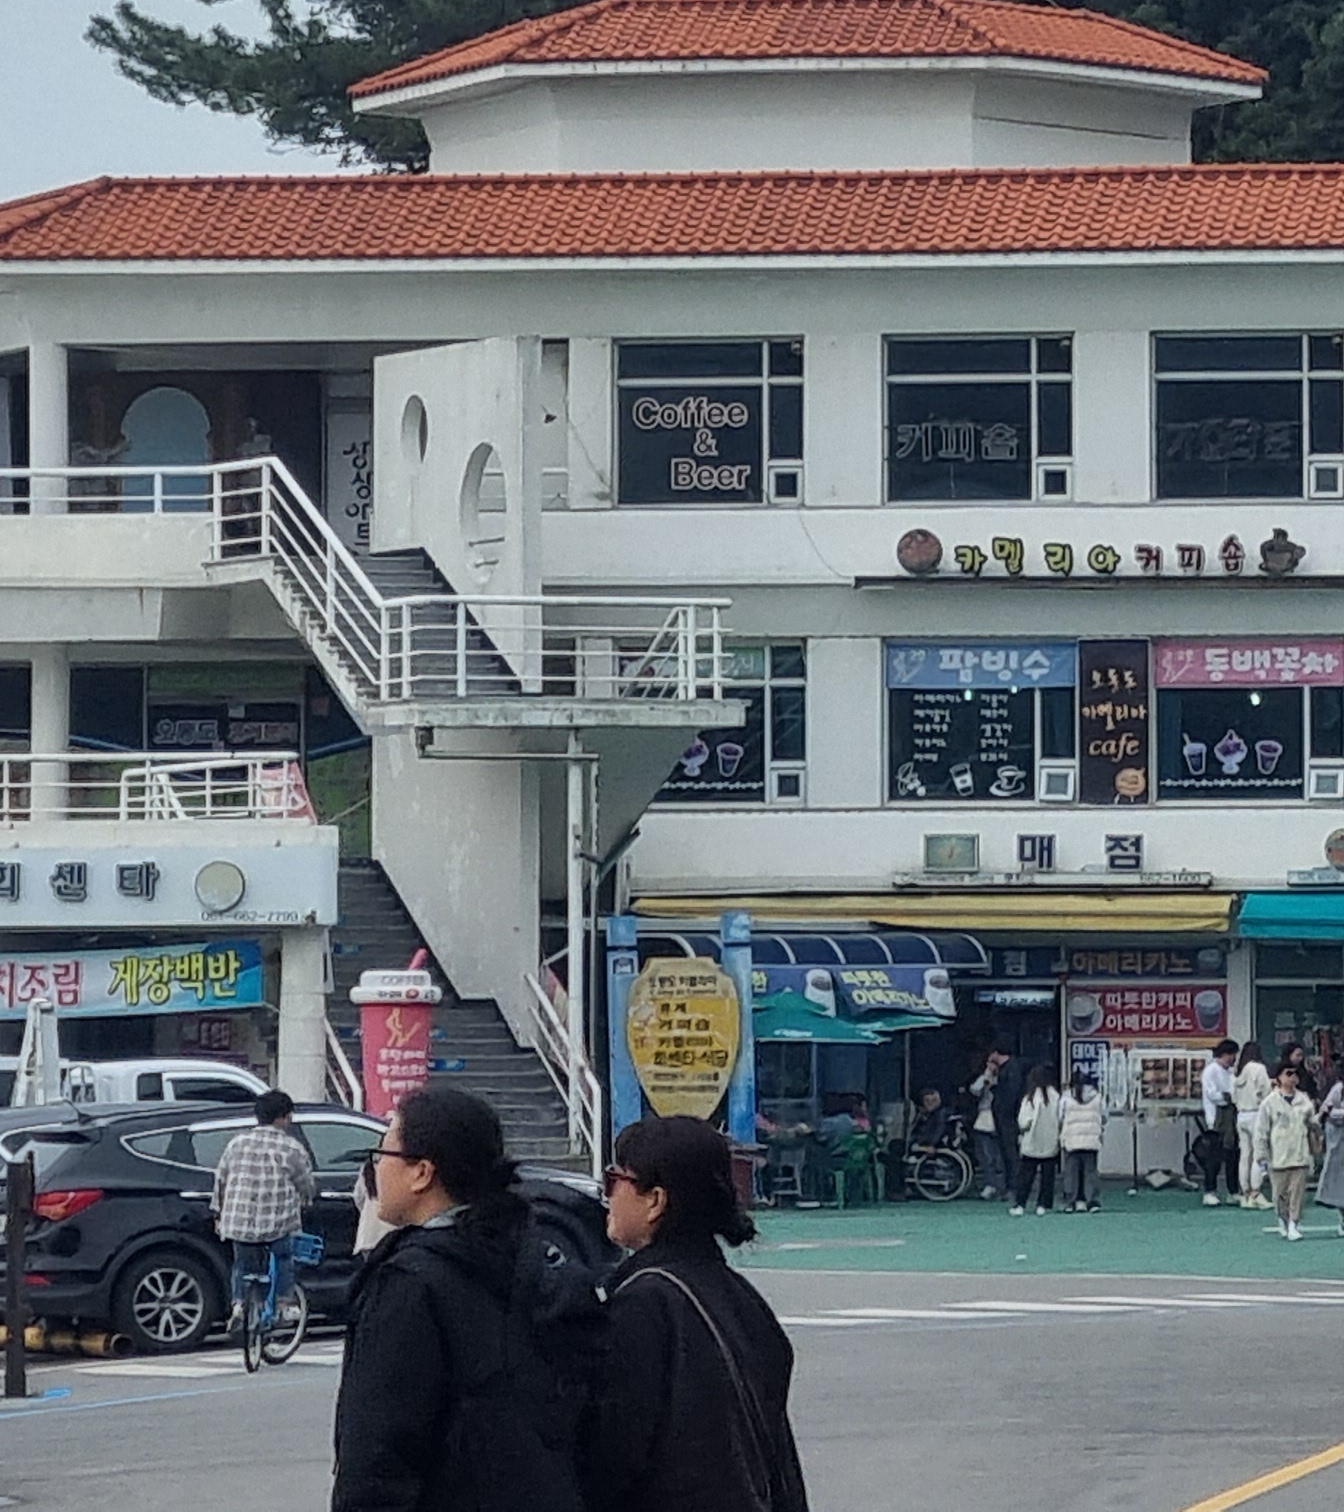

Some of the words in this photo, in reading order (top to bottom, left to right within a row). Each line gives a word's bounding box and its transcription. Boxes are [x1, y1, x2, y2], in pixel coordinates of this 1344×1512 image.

[633, 397, 748, 429] Coffee
[693, 428, 719, 456] &
[670, 458, 751, 490] Beer
[1204, 646, 1340, 683] 동백꽃차
[1088, 732, 1140, 763] cafe
[107, 948, 241, 1007] 게장백반
[1072, 950, 1193, 975] 아메리카노
[1106, 1012, 1195, 1032] 아메리카노
